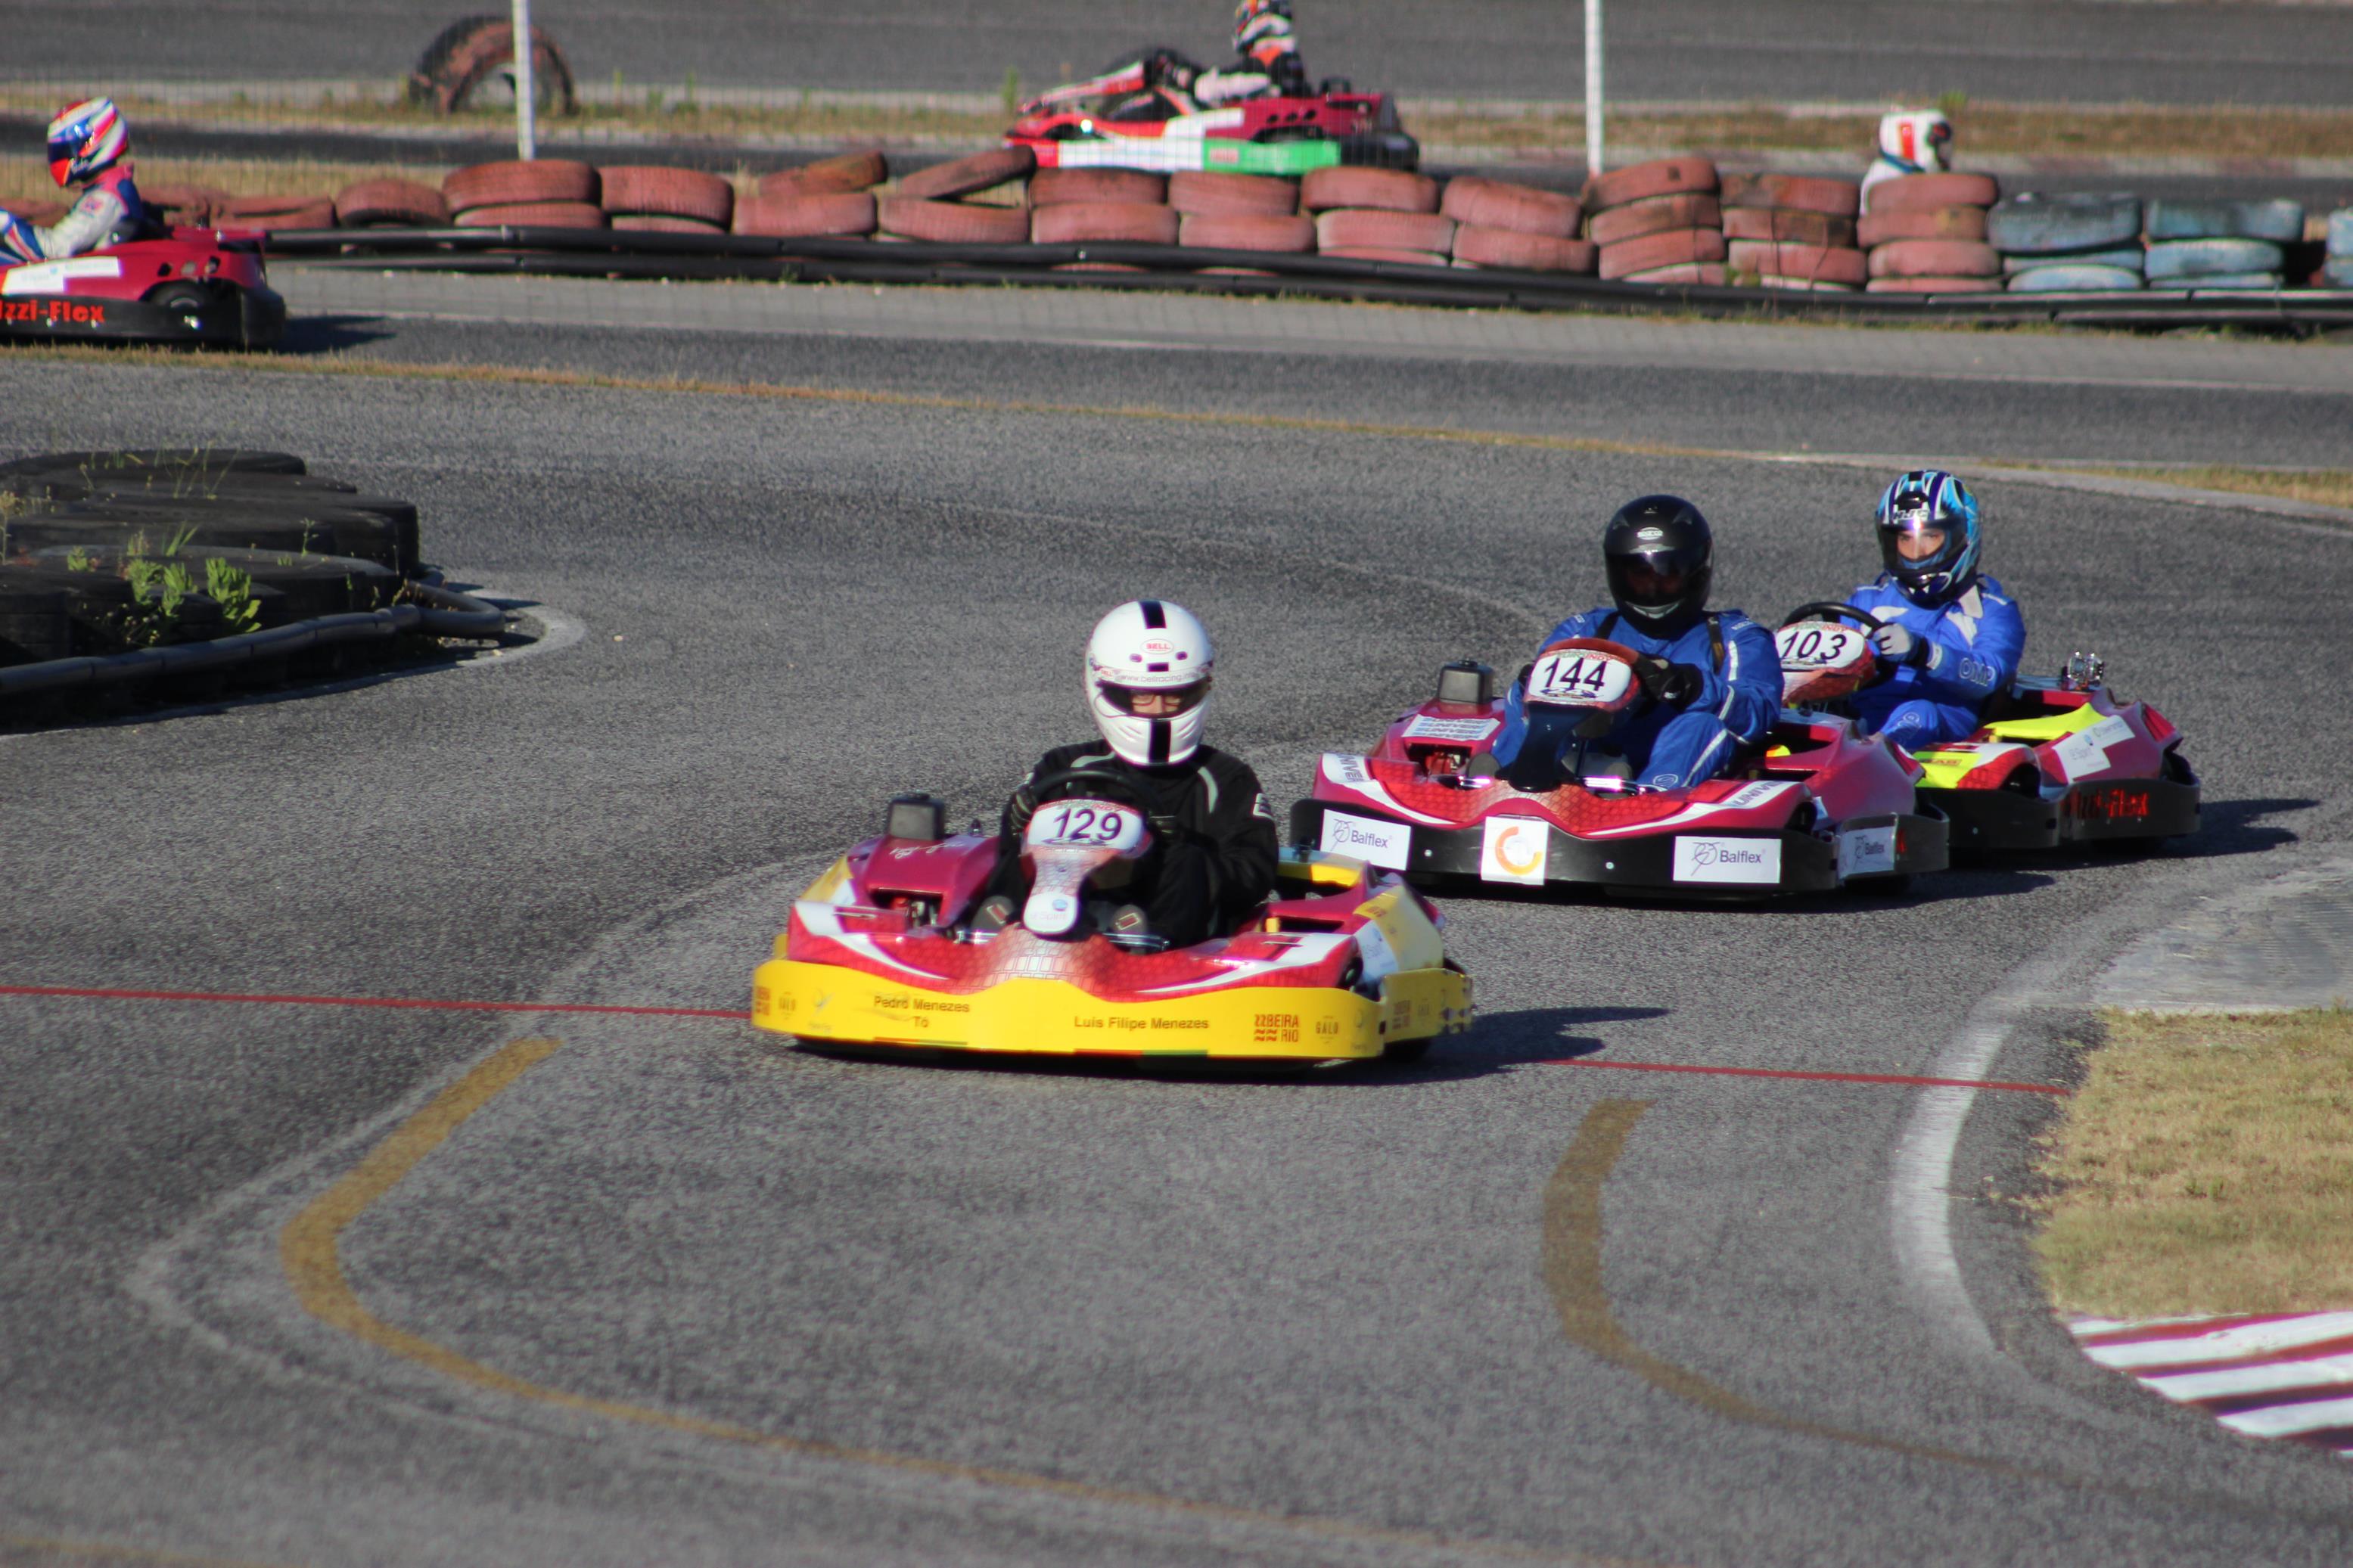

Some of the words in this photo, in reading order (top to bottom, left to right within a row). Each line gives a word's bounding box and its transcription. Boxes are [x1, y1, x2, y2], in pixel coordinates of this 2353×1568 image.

[1782, 630, 1848, 660] 103
[1544, 657, 1608, 691] 144
[1052, 808, 1123, 841] 129
[1351, 830, 1389, 848] Balflex
[1720, 849, 1762, 863] Balflex
[873, 995, 909, 1009] Pedro
[912, 998, 971, 1012] Menezes
[1074, 1016, 1104, 1028] Luis
[1108, 1017, 1146, 1032] Filipe
[1150, 1017, 1210, 1029] Menezes
[1315, 1021, 1339, 1035] GALO
[1280, 1029, 1300, 1042] RIO
